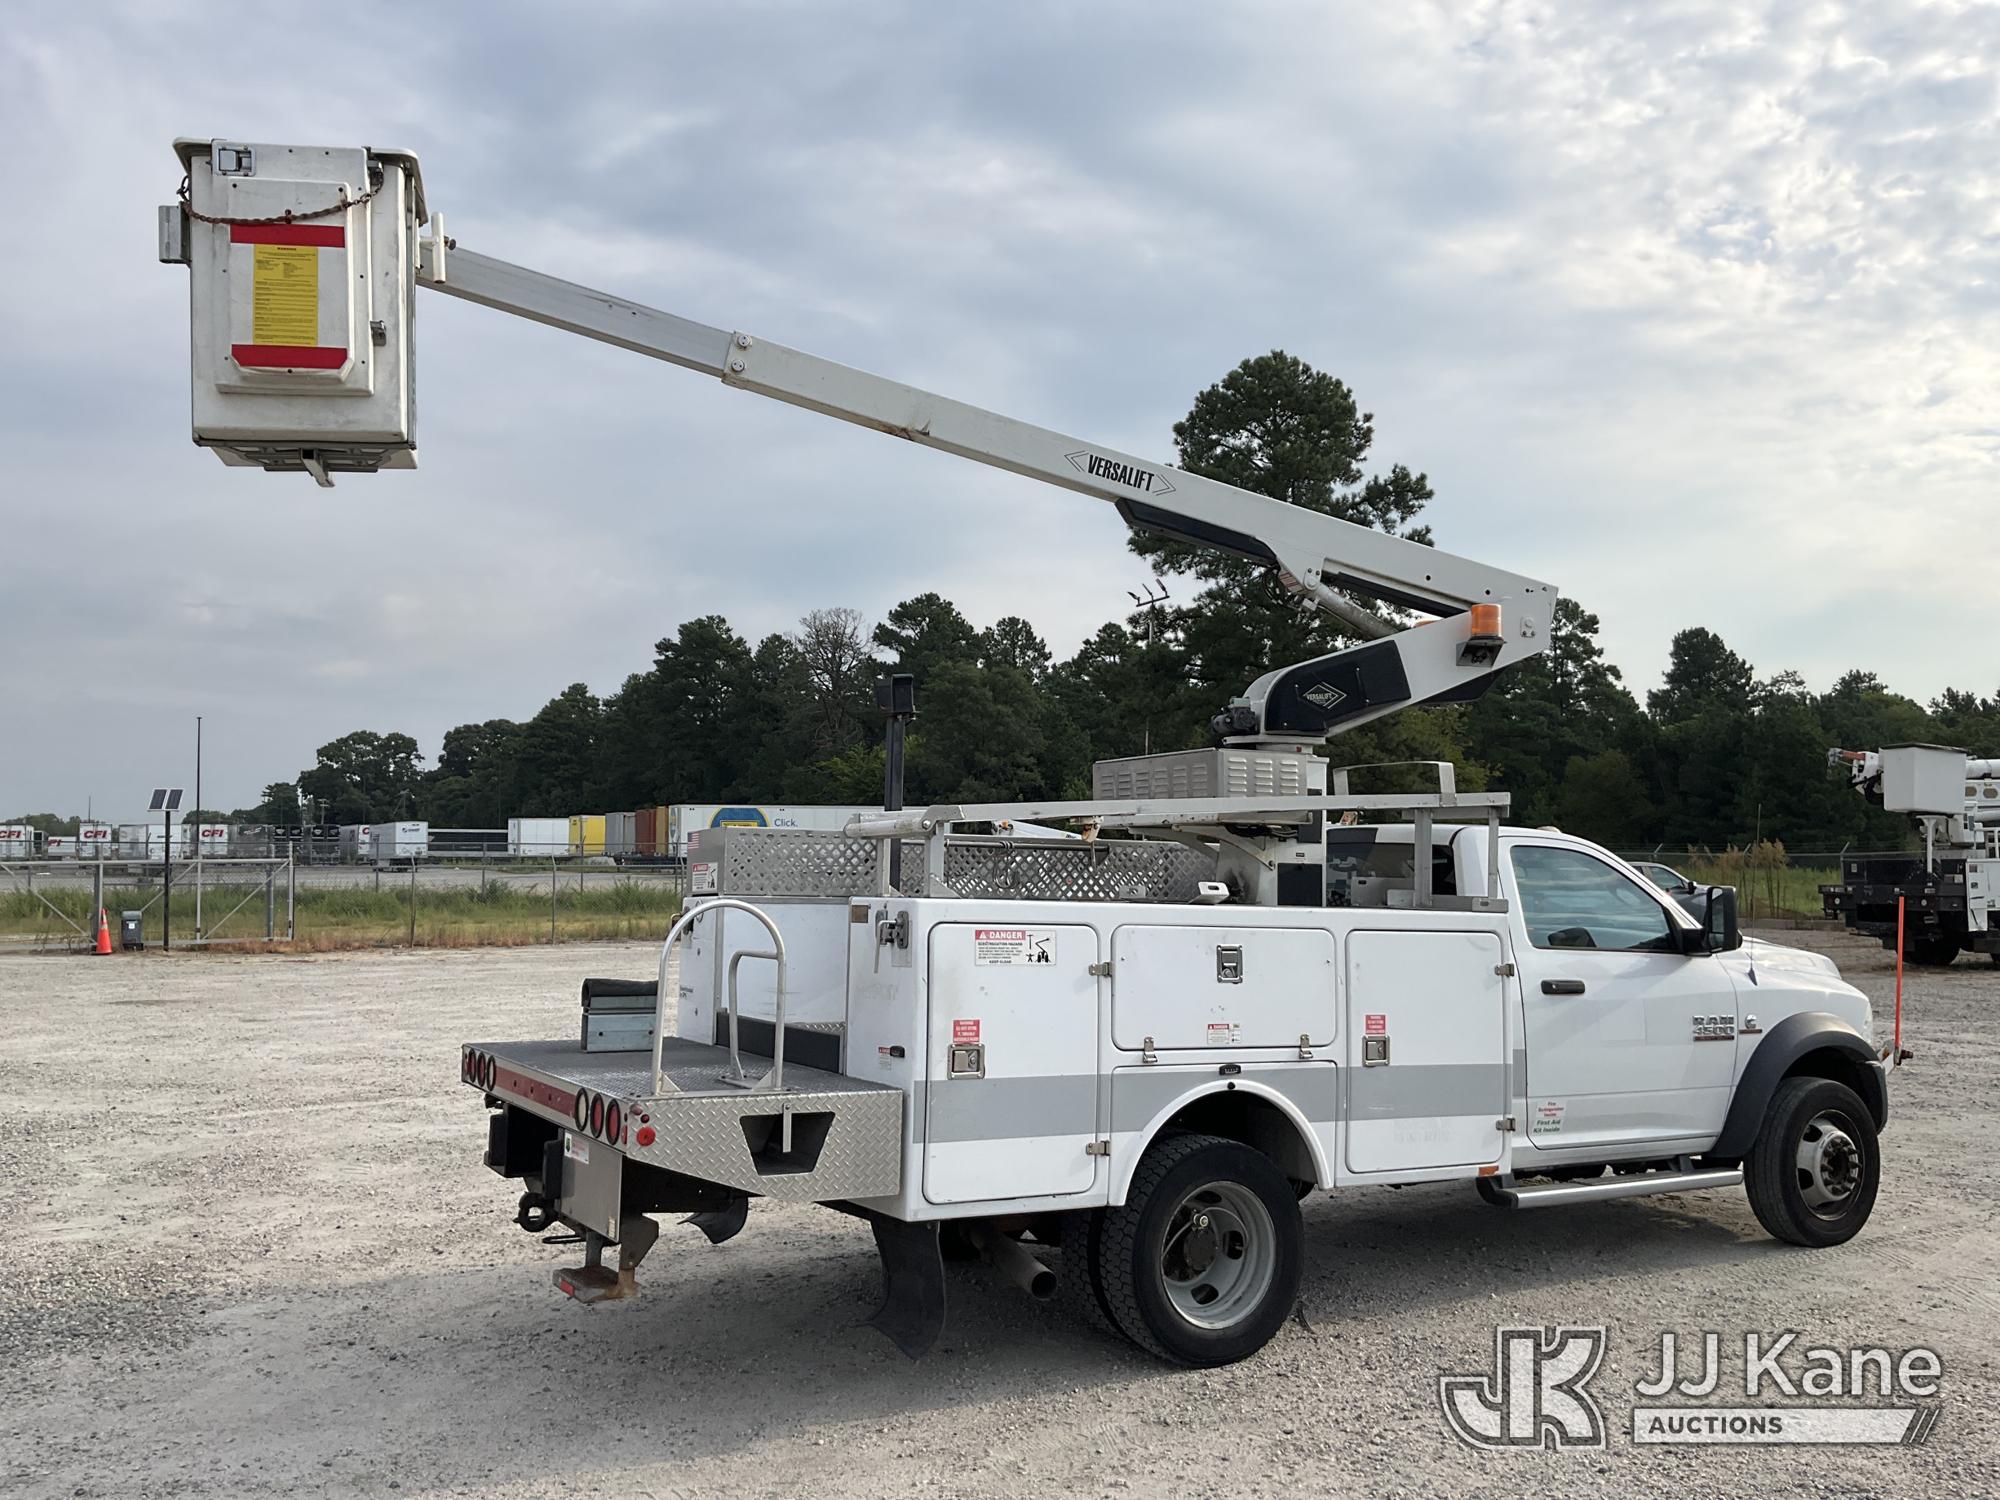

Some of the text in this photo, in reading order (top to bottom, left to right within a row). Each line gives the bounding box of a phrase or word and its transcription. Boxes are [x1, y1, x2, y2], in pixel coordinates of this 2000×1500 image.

[1087, 454, 1155, 491] VERSALIFT
[774, 818, 798, 828] Click.
[0, 830, 22, 839] CFI
[83, 830, 108, 839] CFI
[201, 829, 224, 838] CFI
[989, 931, 1023, 939] DANGER
[1692, 1014, 1735, 1025] RAM
